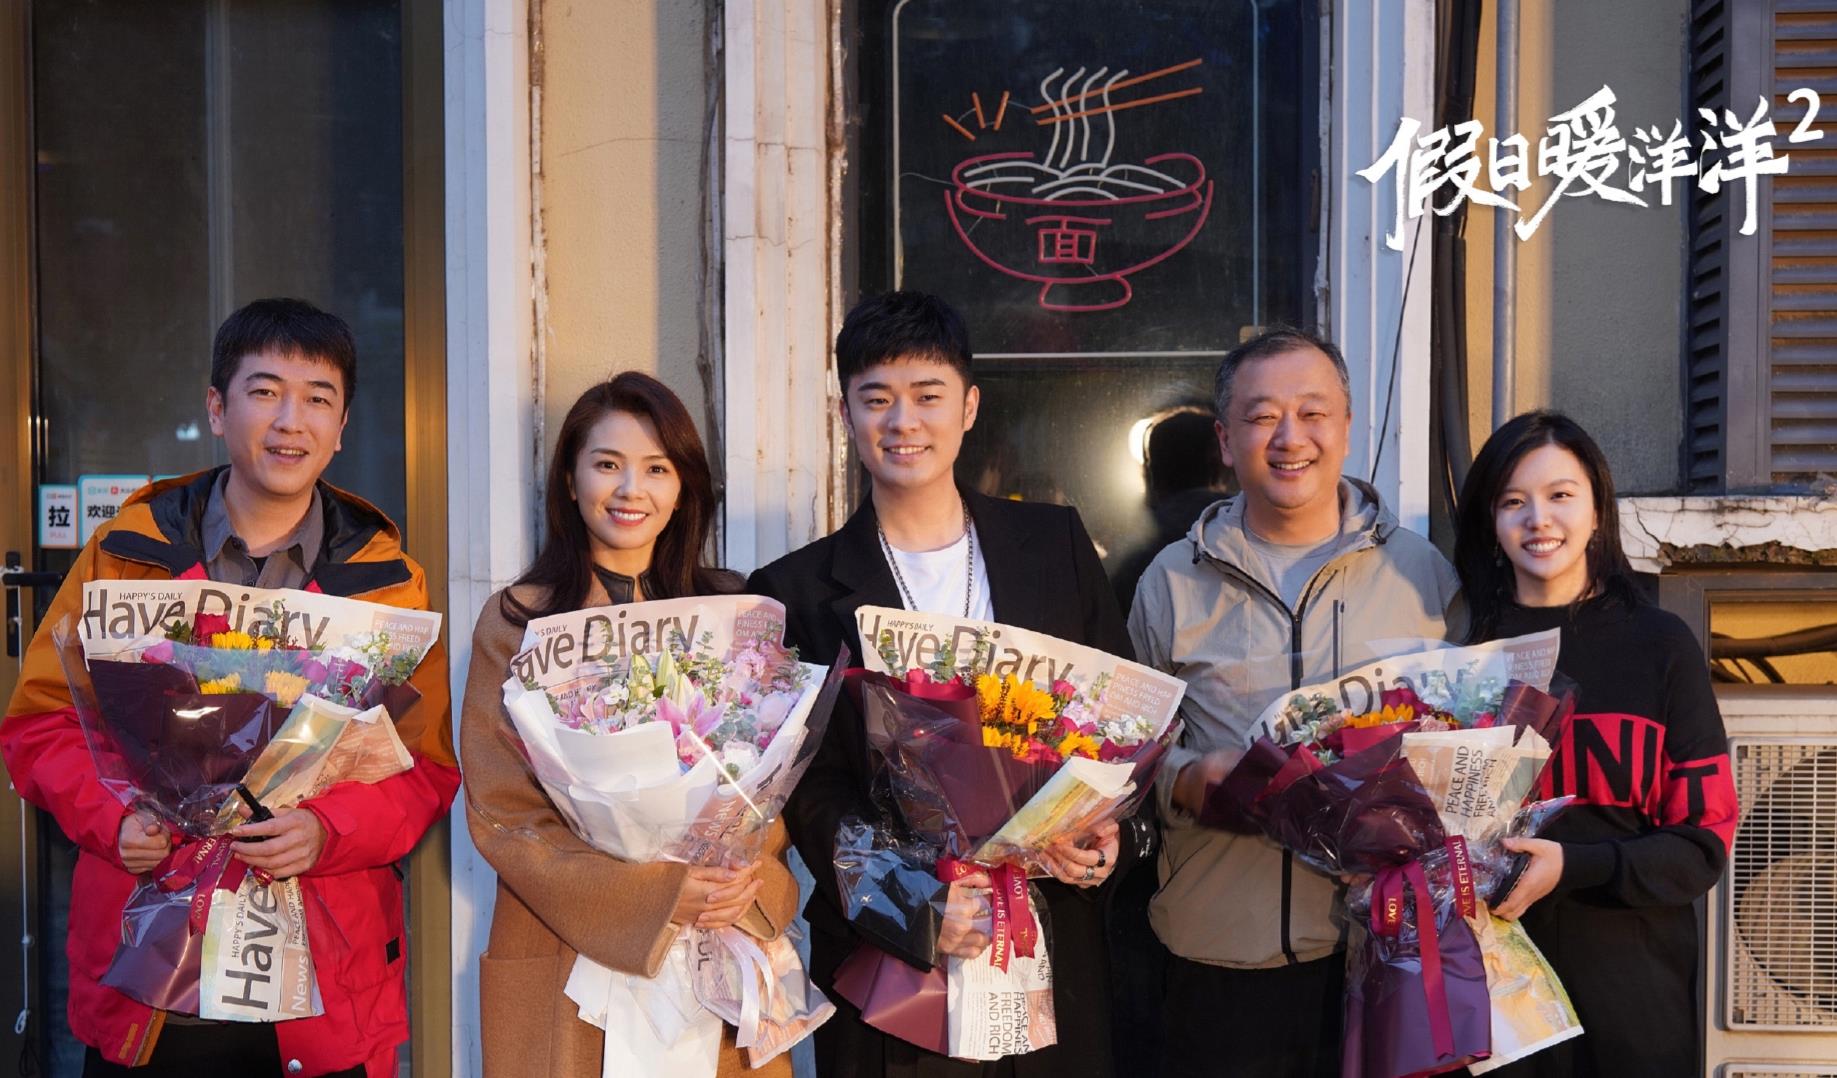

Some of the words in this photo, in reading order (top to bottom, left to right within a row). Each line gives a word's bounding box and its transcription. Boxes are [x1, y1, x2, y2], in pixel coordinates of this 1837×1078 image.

[1025, 215, 1112, 265] 面
[48, 505, 71, 528] 拉
[87, 504, 120, 519] 欢迎
[84, 588, 186, 640] Have
[119, 592, 156, 601] HAPPY'S
[158, 592, 183, 601] DAILY
[513, 632, 575, 684] ave
[582, 610, 700, 663] Diary
[951, 625, 1075, 685] Diary
[1454, 745, 1470, 776] AND
[1444, 777, 1465, 814] PEACE
[1460, 749, 1484, 818] HAPPINESS
[236, 893, 248, 920] DAILY
[1461, 886, 1470, 896] IS
[997, 909, 1005, 919] IS
[221, 882, 278, 1010] Have
[231, 920, 247, 958] HAPPY'S
[291, 954, 309, 1012] News
[988, 992, 1000, 1021] AND
[1001, 992, 1013, 1055] FREEDOM
[1014, 992, 1022, 1054] HAPPINES
[988, 1024, 1001, 1054] RICH
[1021, 1035, 1030, 1054] AN
